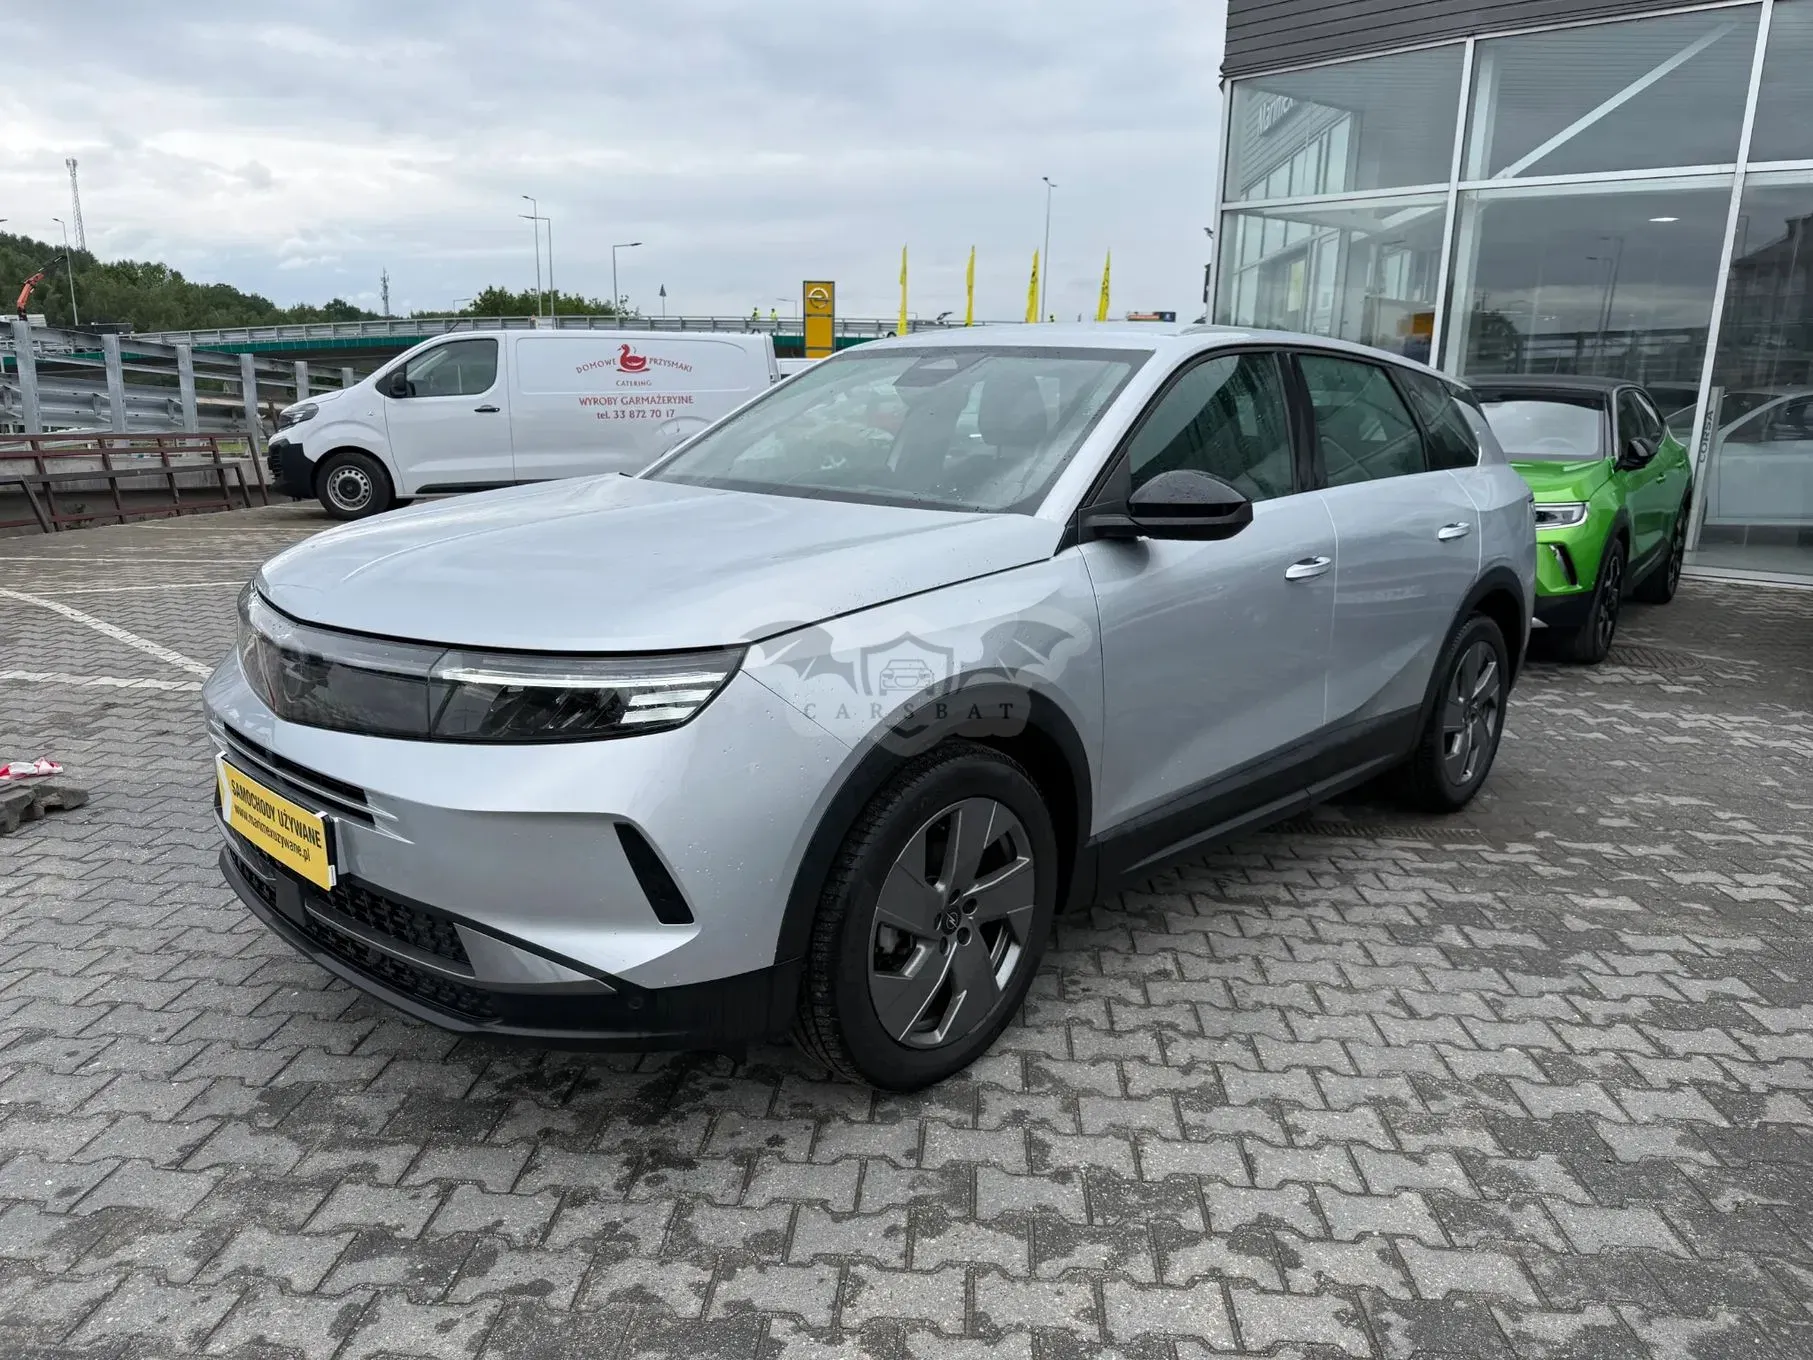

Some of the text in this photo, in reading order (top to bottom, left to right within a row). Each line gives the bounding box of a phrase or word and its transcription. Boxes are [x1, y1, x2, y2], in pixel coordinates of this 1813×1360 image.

[576, 357, 693, 374] DOMOWE PRZYSMAKI
[615, 379, 652, 387] CATERING
[579, 394, 694, 406] WYROBY GARMAŻERYJNE
[597, 409, 675, 419] tel. 33 872 70 17
[1699, 410, 1714, 463] CORSA
[231, 779, 322, 849] SAMOCHODY UŻYWANE
